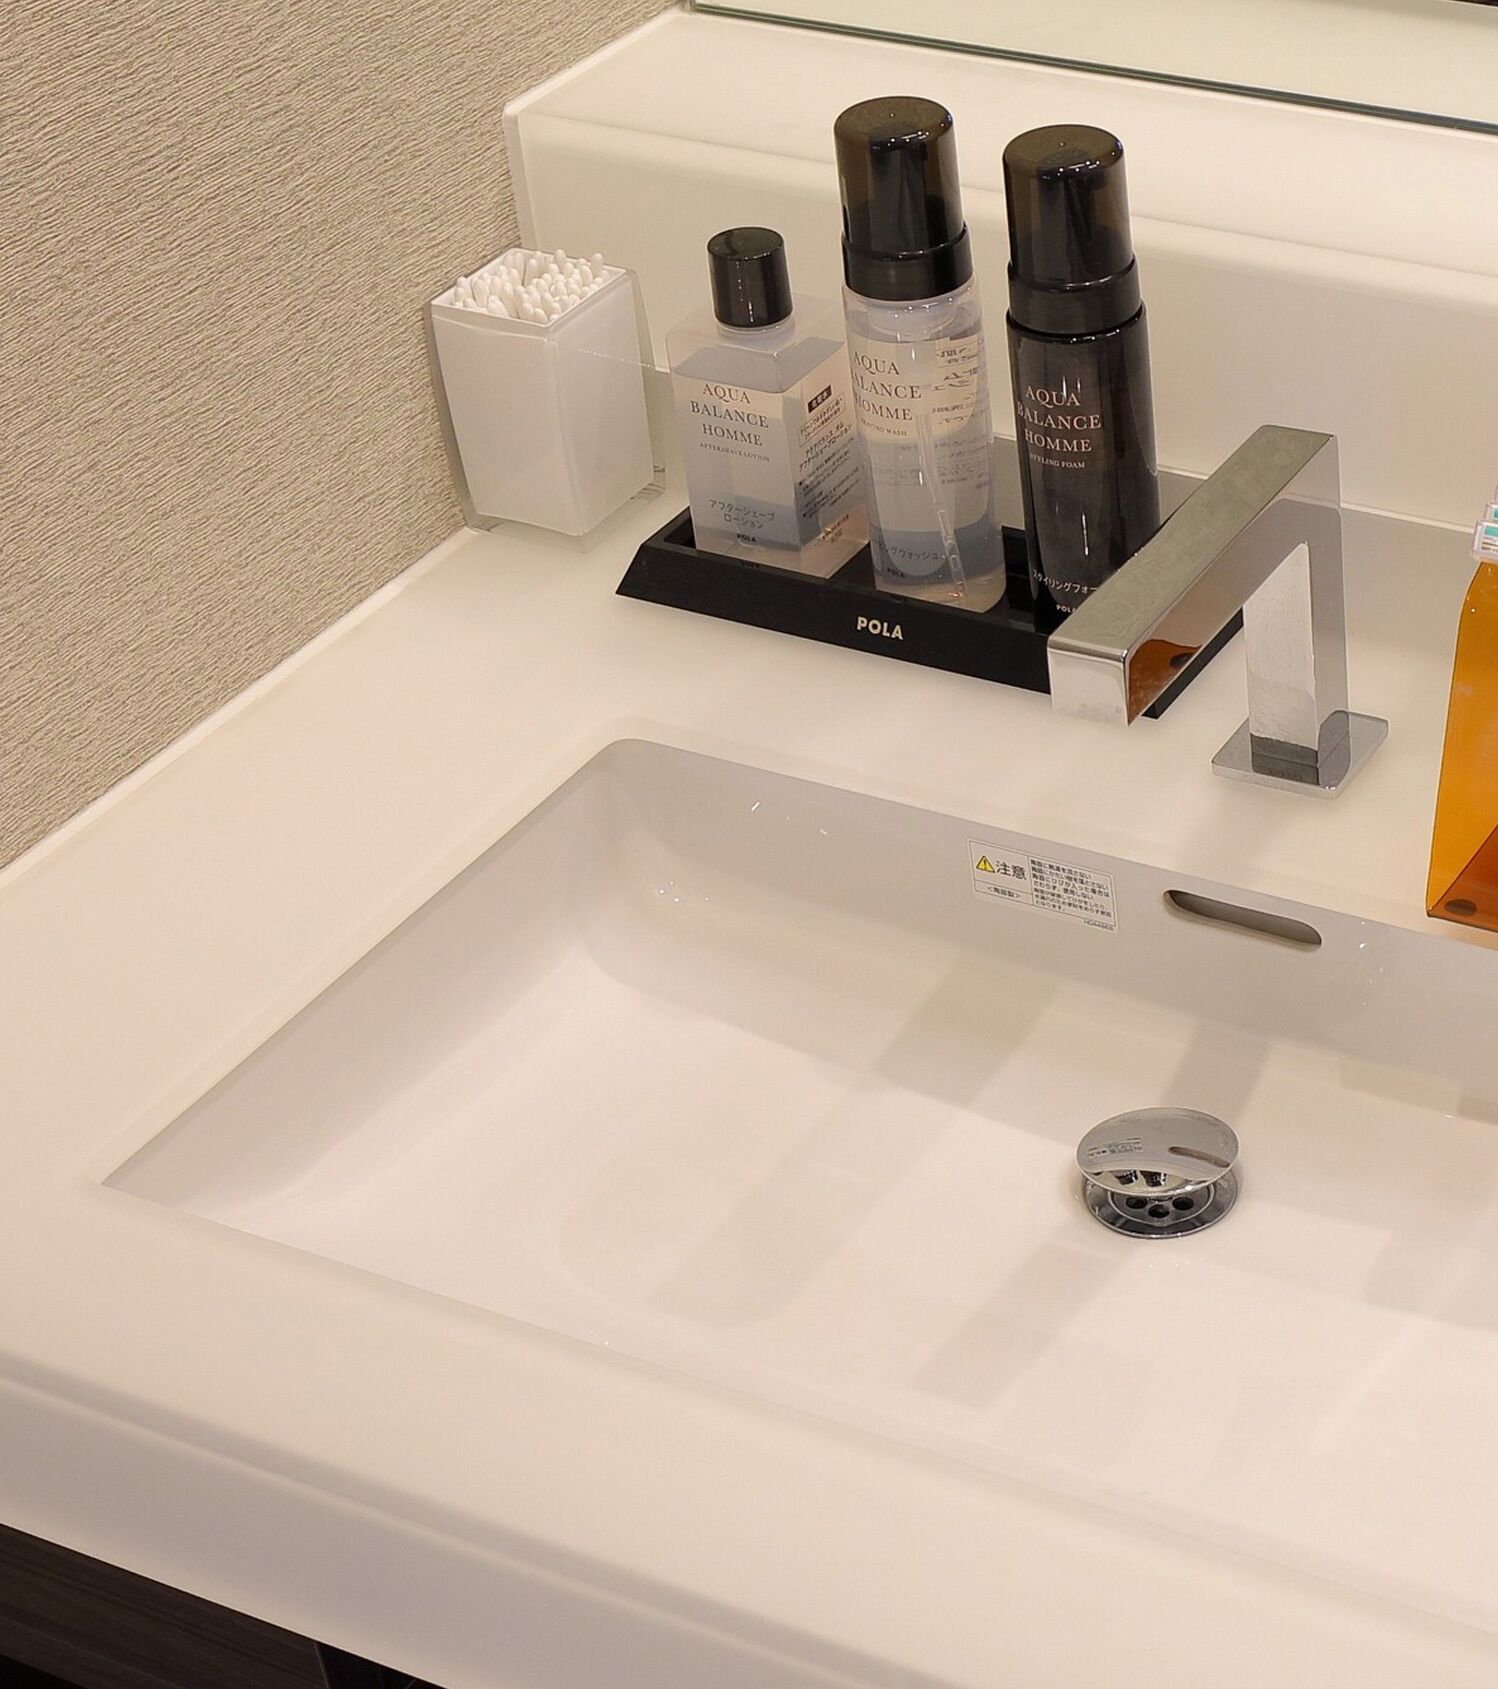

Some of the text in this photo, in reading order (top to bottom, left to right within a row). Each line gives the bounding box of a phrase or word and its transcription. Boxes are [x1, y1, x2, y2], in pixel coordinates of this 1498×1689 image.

[854, 351, 901, 376] AQUA
[702, 383, 751, 404] AQUA
[851, 371, 922, 399] ALANCE
[1025, 385, 1081, 409] AQUA
[690, 401, 769, 428] BALANCE
[1017, 400, 1102, 431] BALANCE
[702, 425, 763, 446] HOMME
[1024, 428, 1092, 452] HOMME
[1030, 453, 1060, 467] STYLING
[724, 514, 764, 529] ローション
[737, 533, 757, 543] POLA
[1032, 569, 1097, 594] スタイリングフォー
[857, 616, 903, 640] POLA
[996, 859, 1027, 881] 注意
